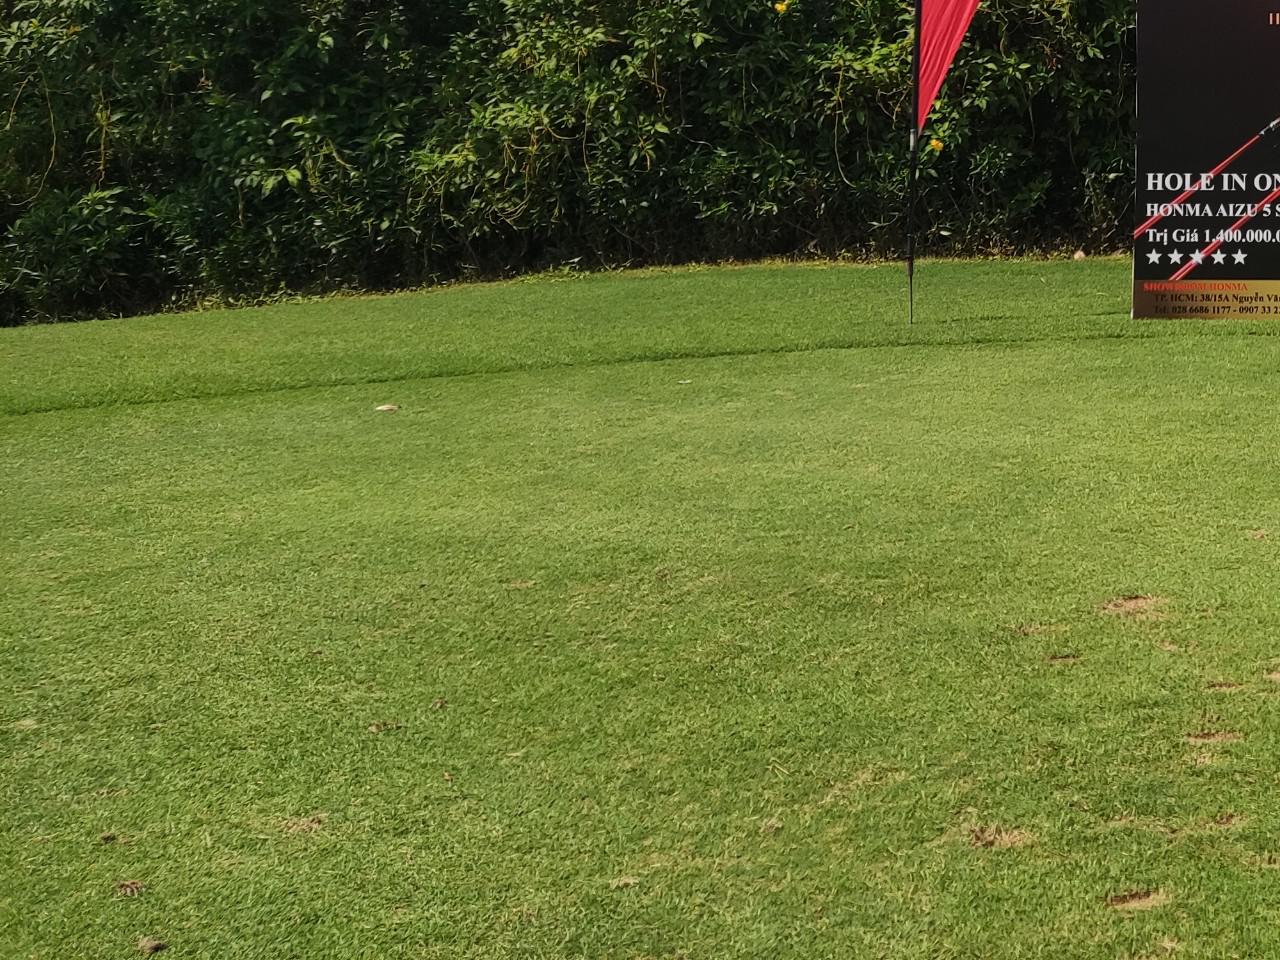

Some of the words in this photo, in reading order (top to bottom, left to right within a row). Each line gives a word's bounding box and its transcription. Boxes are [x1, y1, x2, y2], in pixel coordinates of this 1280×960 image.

[1146, 172, 1215, 191] HOLE
[1221, 172, 1247, 191] IN
[1146, 203, 1213, 217] HONMA
[1216, 203, 1258, 217] AIZU
[1262, 204, 1272, 217] 5
[1145, 228, 1168, 246] Trị
[1172, 228, 1199, 243] Giá
[1209, 282, 1248, 291] HONMA
[1170, 294, 1198, 303] HCM:
[1200, 293, 1230, 302] 38/15A
[1212, 305, 1231, 314] 1177
[1238, 305, 1259, 314] 0907
[1260, 306, 1271, 314] 33
